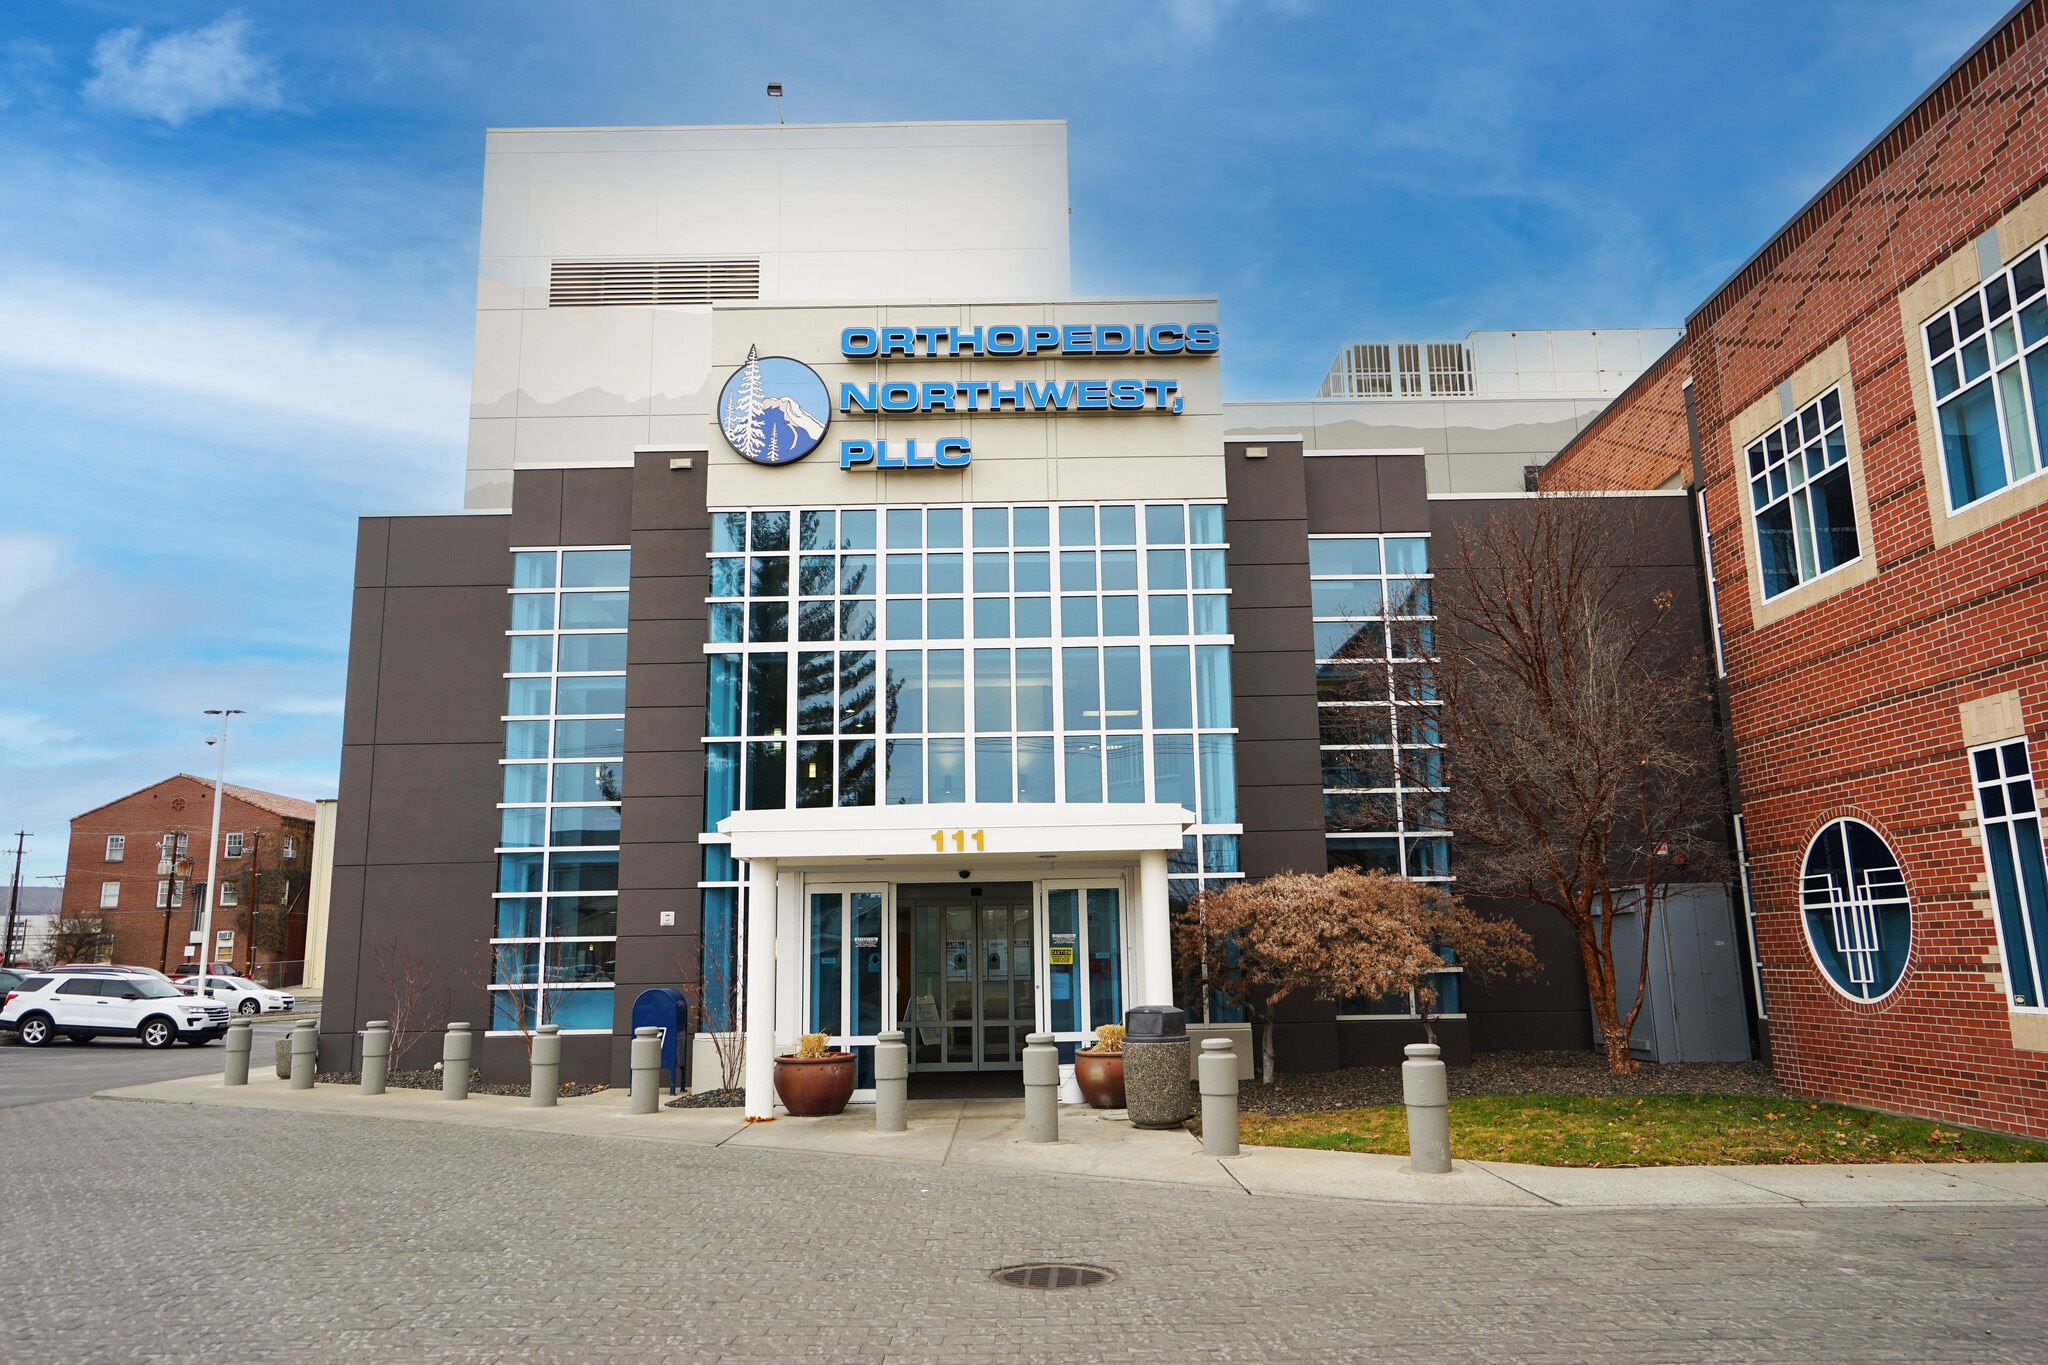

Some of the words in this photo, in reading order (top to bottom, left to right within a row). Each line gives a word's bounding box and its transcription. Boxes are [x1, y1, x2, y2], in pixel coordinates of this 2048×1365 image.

[841, 324, 1220, 358] ORTHOPEDICS
[840, 379, 1185, 414] NORTHWEST,
[840, 437, 972, 471] PLLC
[931, 829, 984, 852] 111
